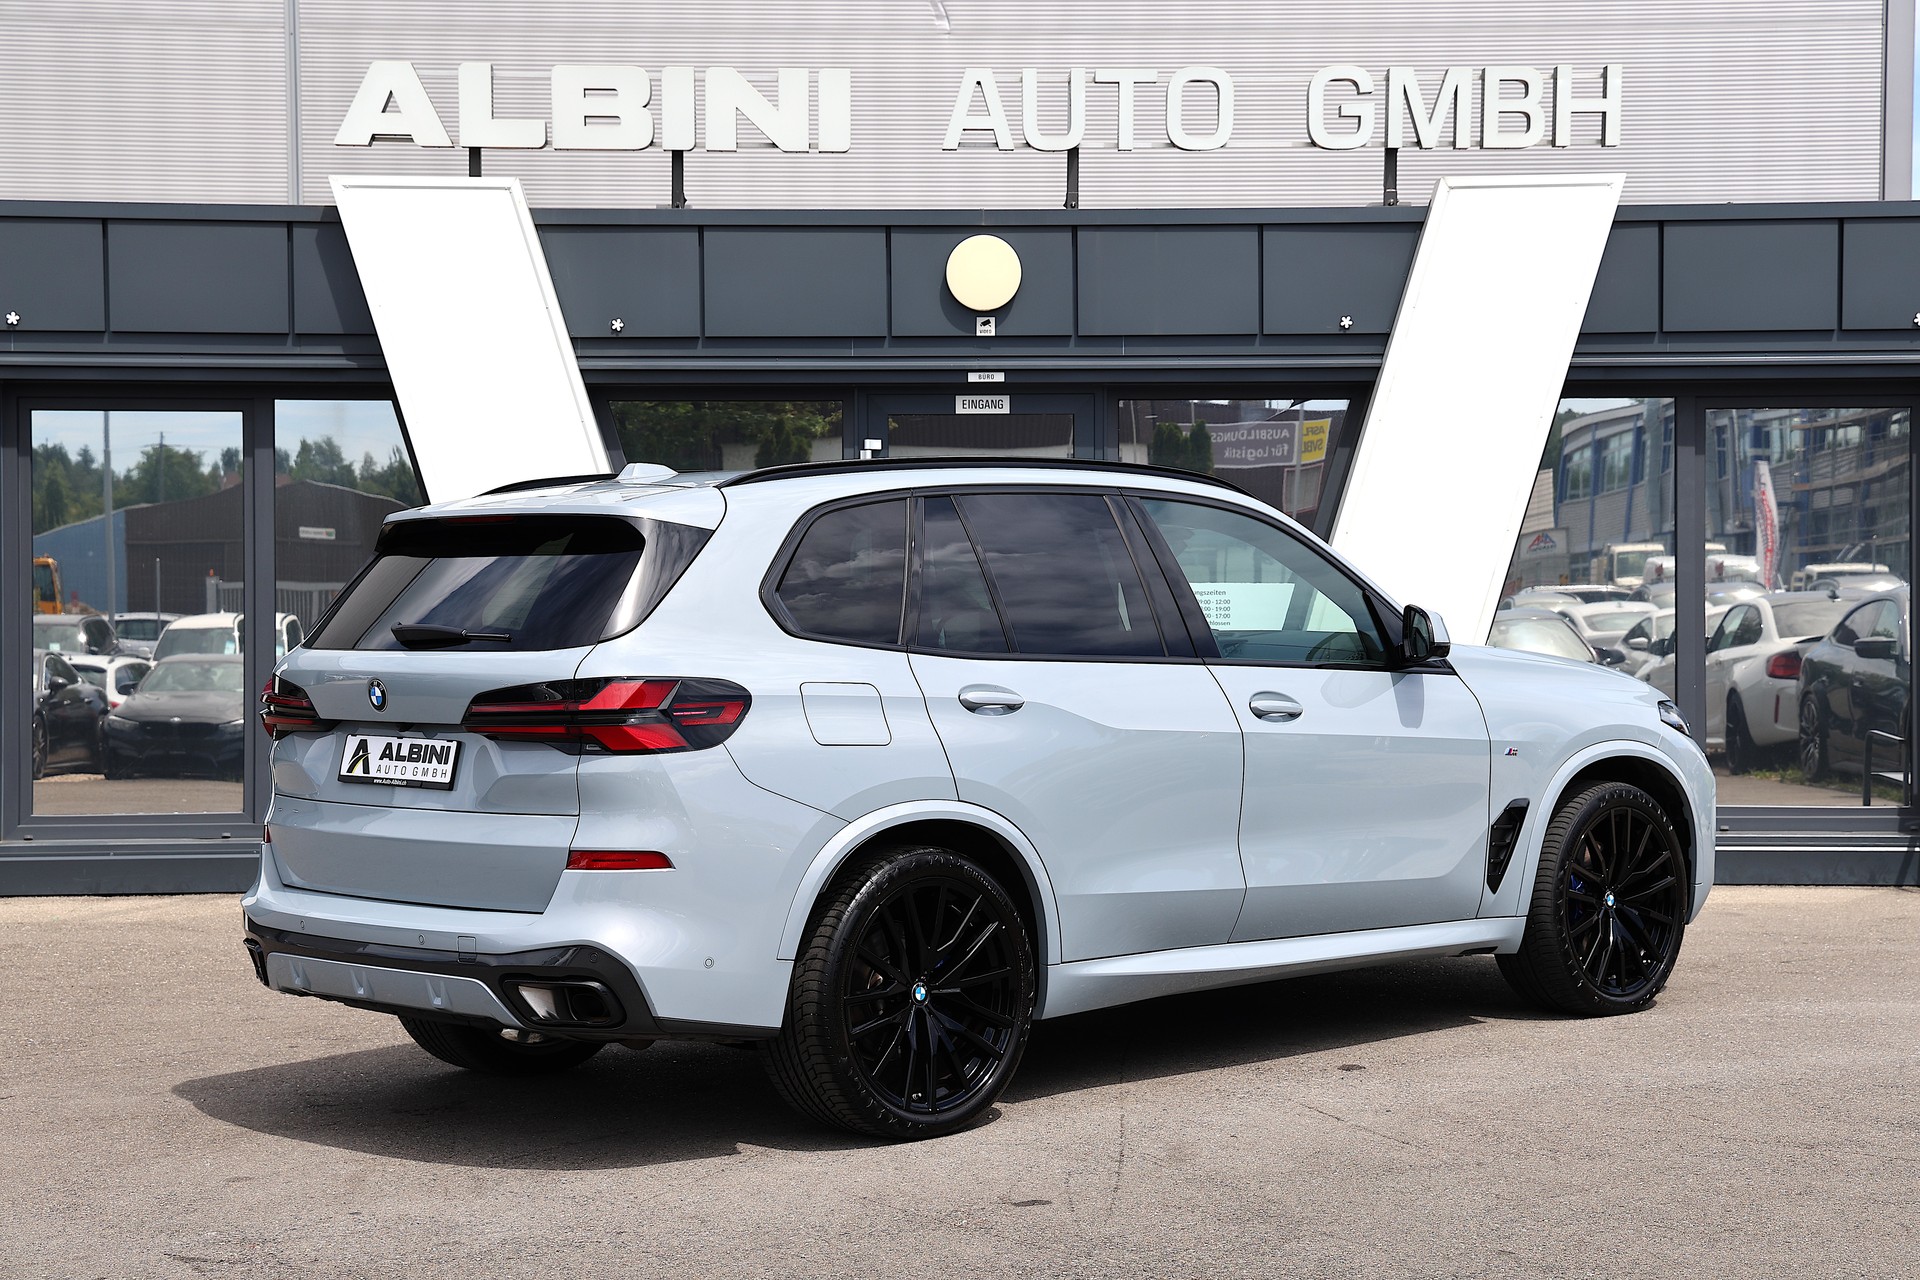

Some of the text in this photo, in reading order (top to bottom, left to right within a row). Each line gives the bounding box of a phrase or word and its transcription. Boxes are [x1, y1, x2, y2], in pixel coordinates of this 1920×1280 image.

[334, 61, 1623, 153] ALBINI AUTO GMBH
[962, 399, 1004, 410] EINGANG
[378, 742, 452, 765] ALBINI
[376, 764, 448, 778] AUTO GMBH
